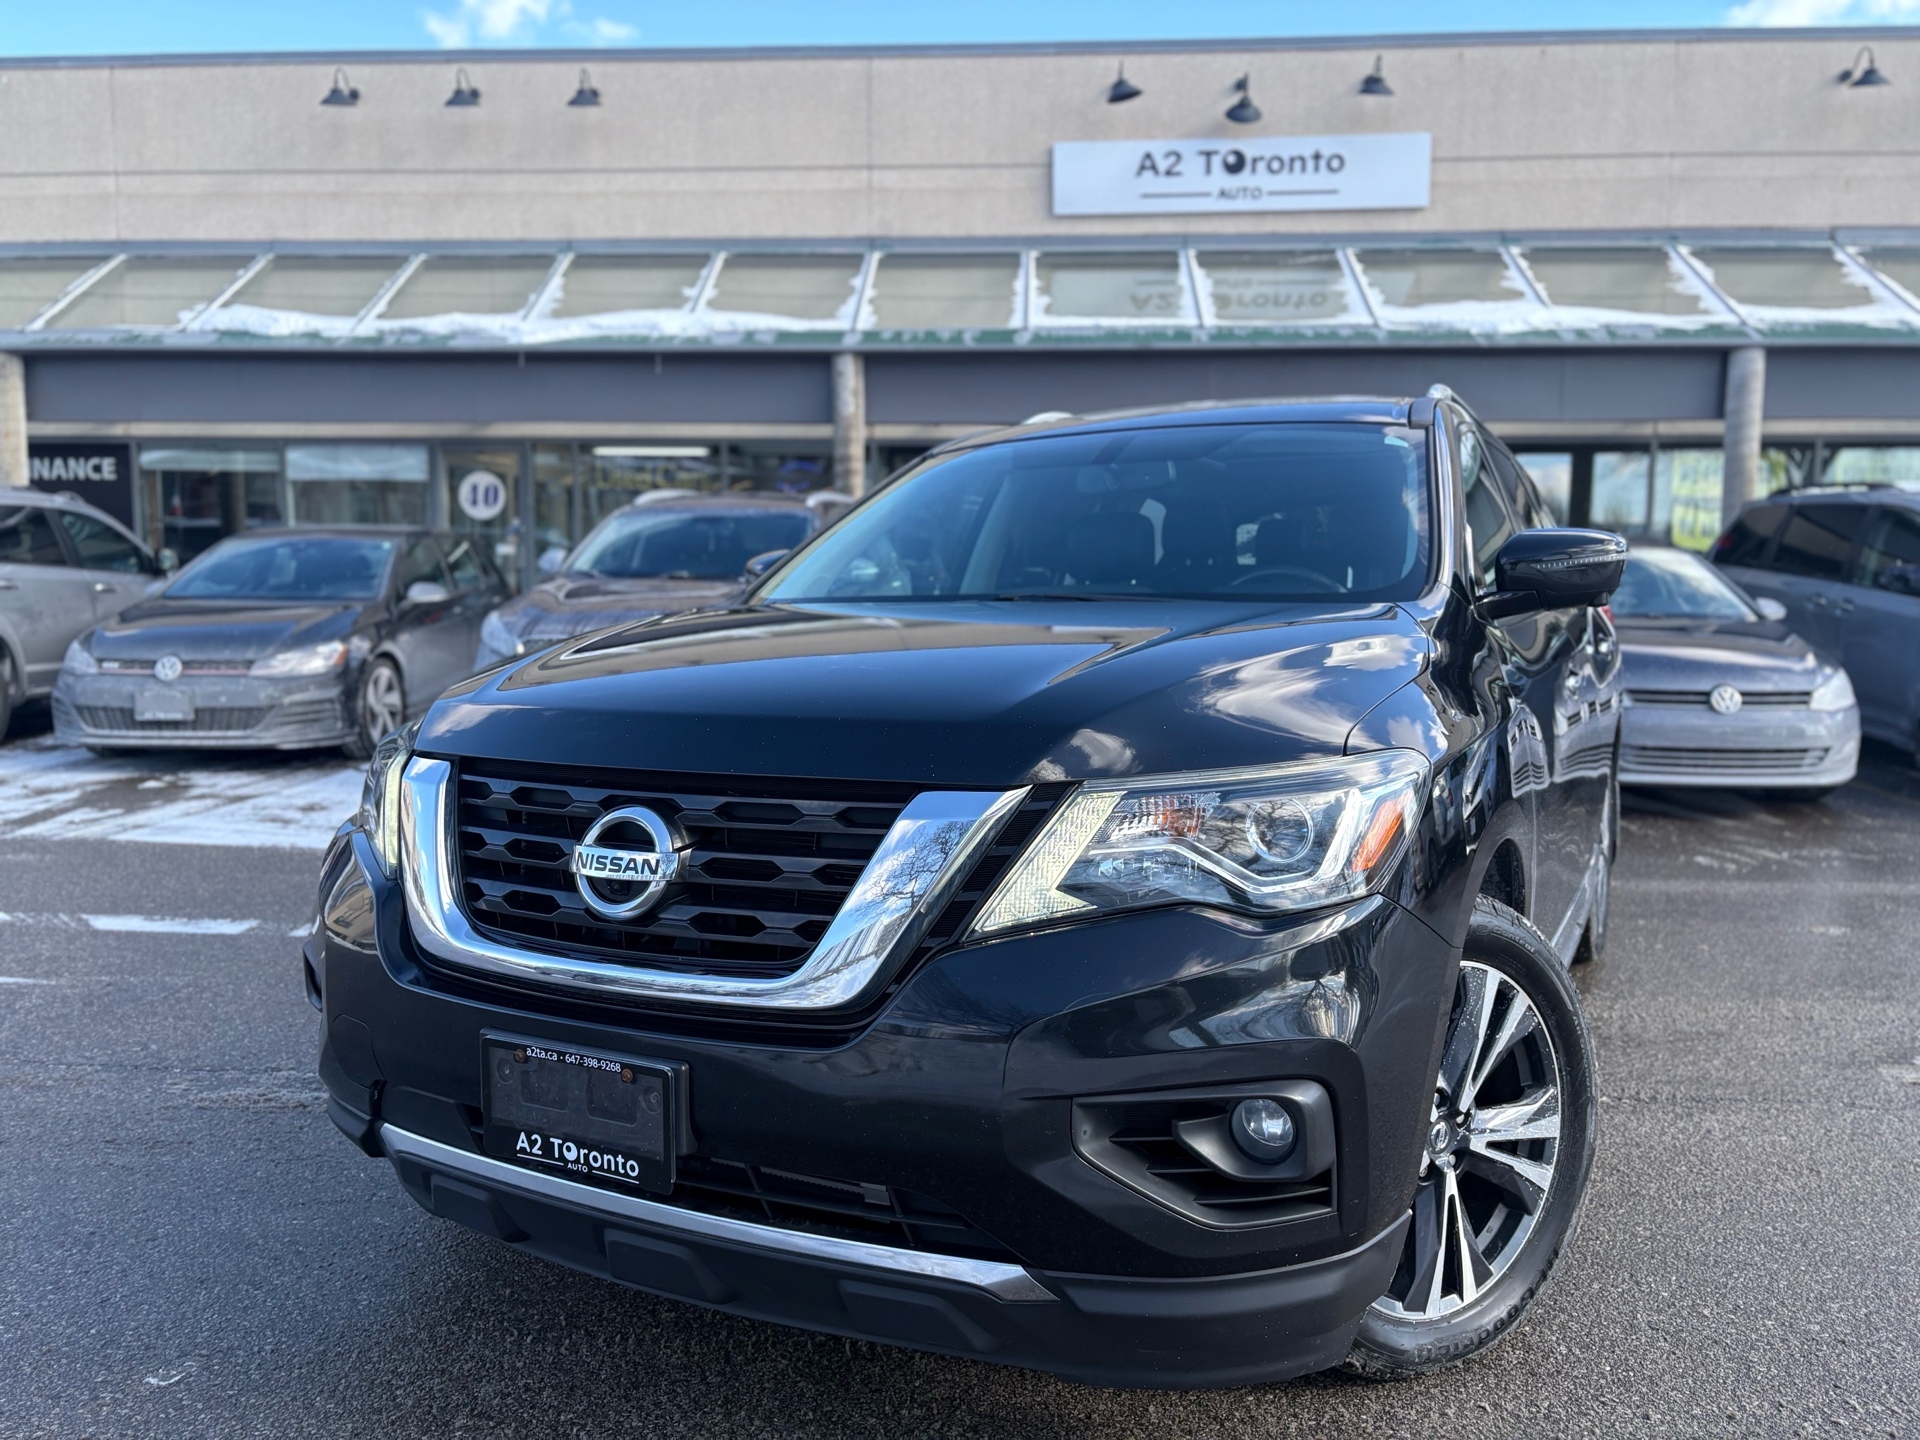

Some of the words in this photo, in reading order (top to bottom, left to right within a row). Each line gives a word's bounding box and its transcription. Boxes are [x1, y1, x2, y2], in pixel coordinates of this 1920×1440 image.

[1136, 151, 1182, 177] A2
[1216, 188, 1262, 201] AUTO
[577, 851, 660, 875] NISSAN
[526, 1047, 558, 1061] a2ta.ca
[565, 1054, 621, 1073] 647-398-9268
[516, 1131, 542, 1155] A2
[567, 1162, 588, 1173] AUTO
